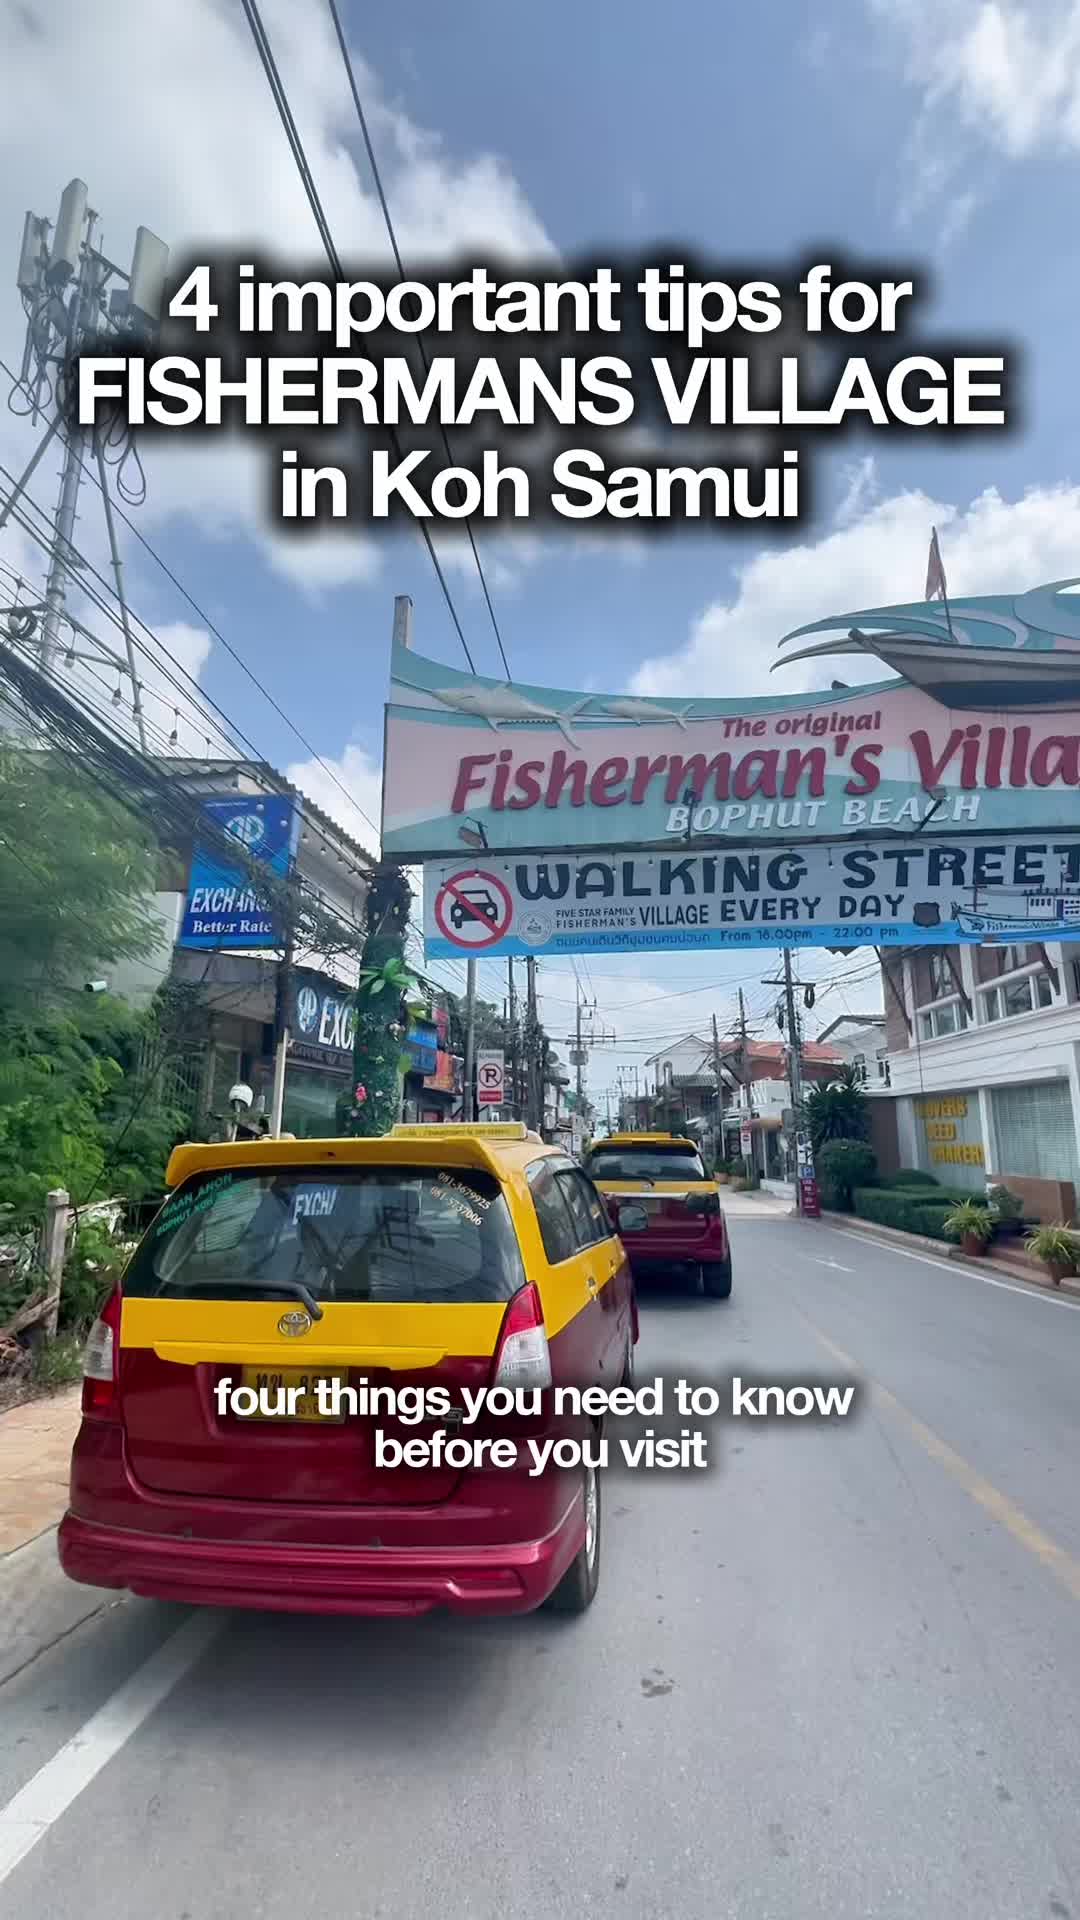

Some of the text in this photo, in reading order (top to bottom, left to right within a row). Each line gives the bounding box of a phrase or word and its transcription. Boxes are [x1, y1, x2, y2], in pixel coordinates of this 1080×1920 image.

[722, 711, 882, 739] The original
[451, 723, 1080, 814] Fisherman's Villa
[664, 793, 981, 834] BOPHUT BEACH
[515, 844, 1080, 901] WALKING STREET
[556, 906, 635, 919] FIVE STAR FAMILY
[556, 917, 637, 930] FISHERMAN'S
[639, 894, 905, 926] VILLAGE EVERY DAY
[193, 919, 237, 934] Better
[720, 930, 751, 943] From
[879, 927, 899, 941] pm
